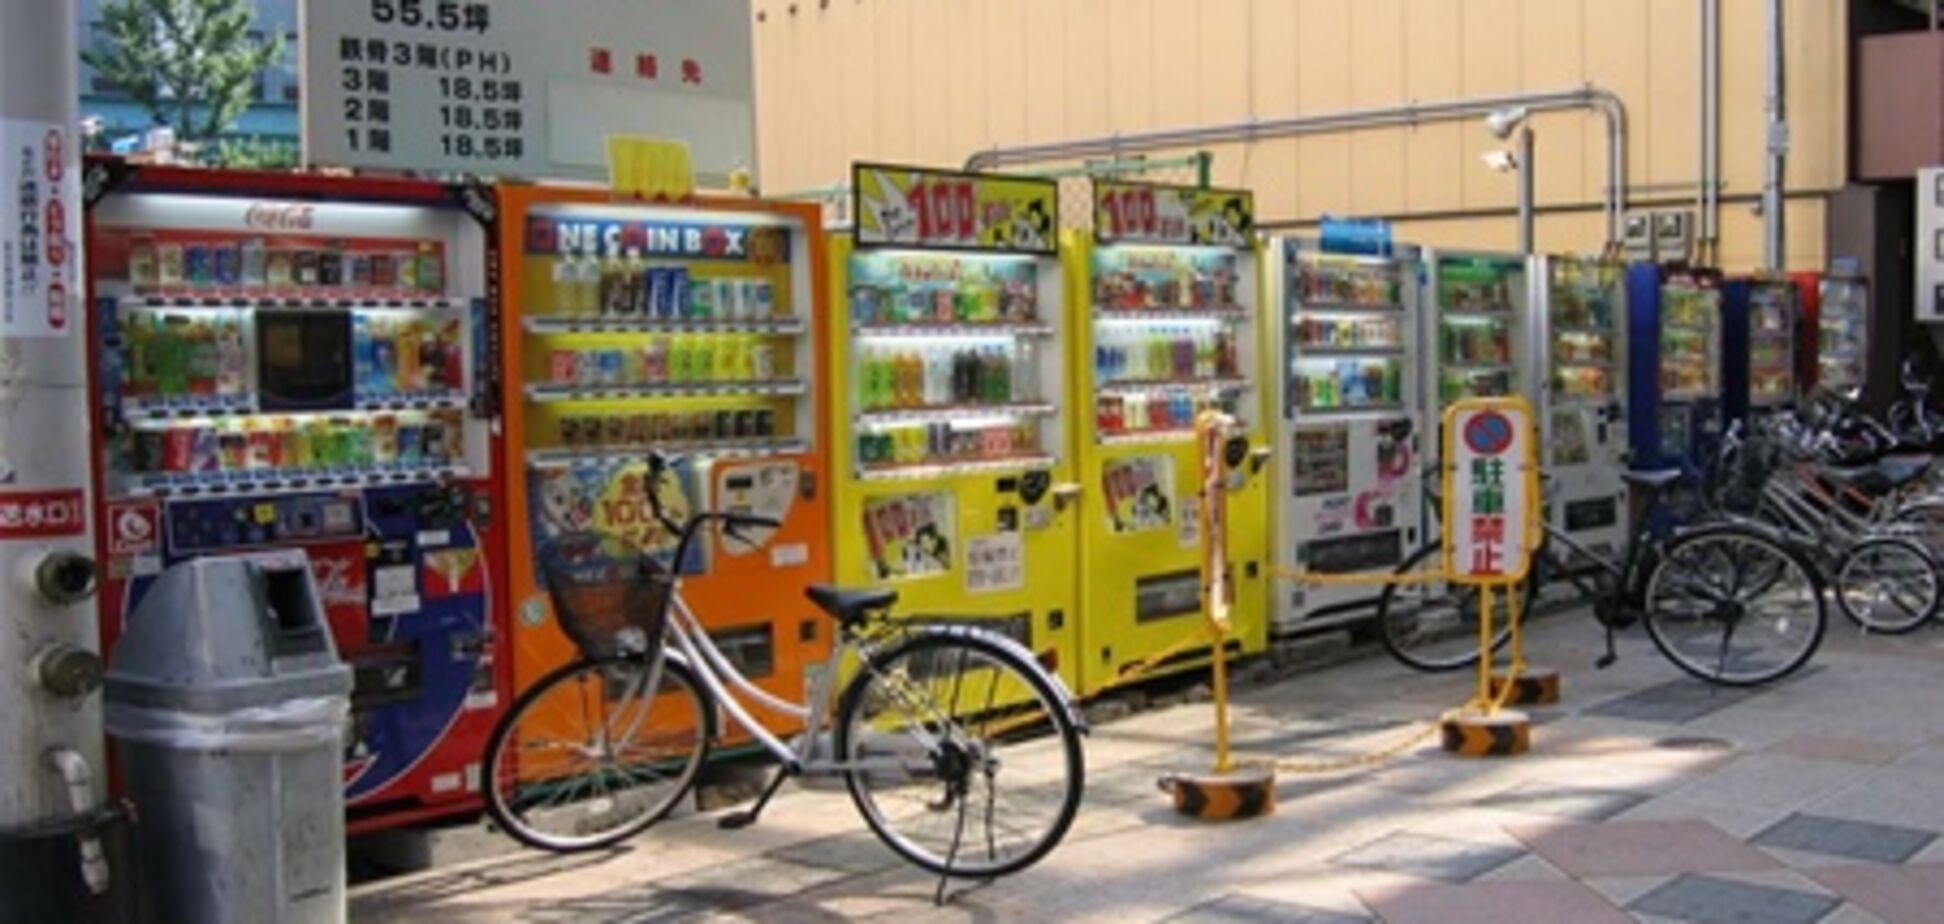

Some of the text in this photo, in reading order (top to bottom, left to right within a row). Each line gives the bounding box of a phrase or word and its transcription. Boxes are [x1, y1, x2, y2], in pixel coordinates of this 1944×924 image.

[371, 0, 490, 34] 55.5坪
[342, 67, 521, 103] 3階 18.5坪
[344, 98, 522, 131] 2階 18.5坪
[347, 128, 523, 159] 1階 18.5坪
[906, 180, 977, 239] 100
[1101, 188, 1156, 236] 100
[603, 220, 680, 255] COIN
[683, 226, 745, 256] BOX
[1471, 456, 1507, 576] 駐車禁止
